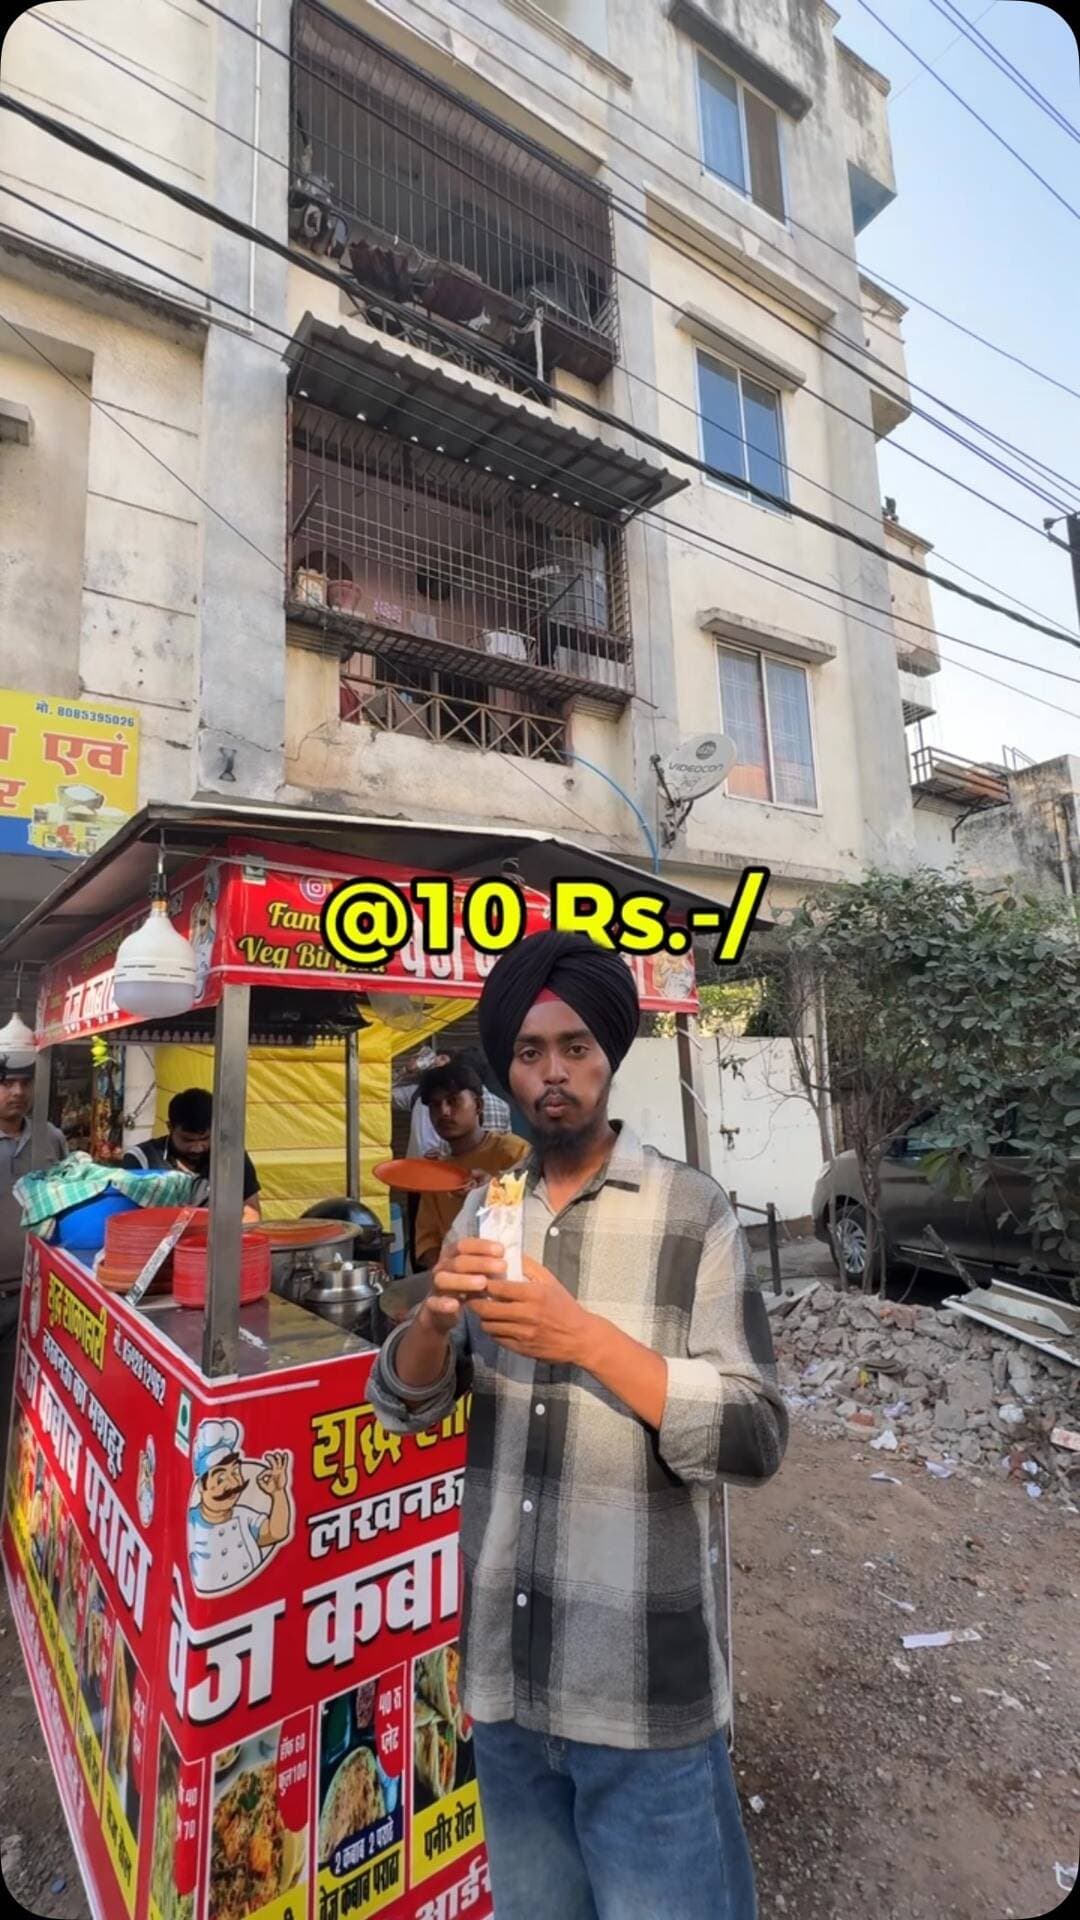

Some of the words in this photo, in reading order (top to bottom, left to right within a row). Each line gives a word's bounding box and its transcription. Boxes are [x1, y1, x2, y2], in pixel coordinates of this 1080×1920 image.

[43, 733, 129, 776] एवं
[238, 938, 289, 969] Veg
[38, 1370, 83, 1496] कबाब
[168, 1562, 286, 1722] वेज
[302, 1539, 459, 1666] कबा
[335, 1851, 342, 1875] 2
[368, 1831, 375, 1854] 2
[424, 1812, 452, 1860] पनीर
[455, 1801, 477, 1842] रोल
